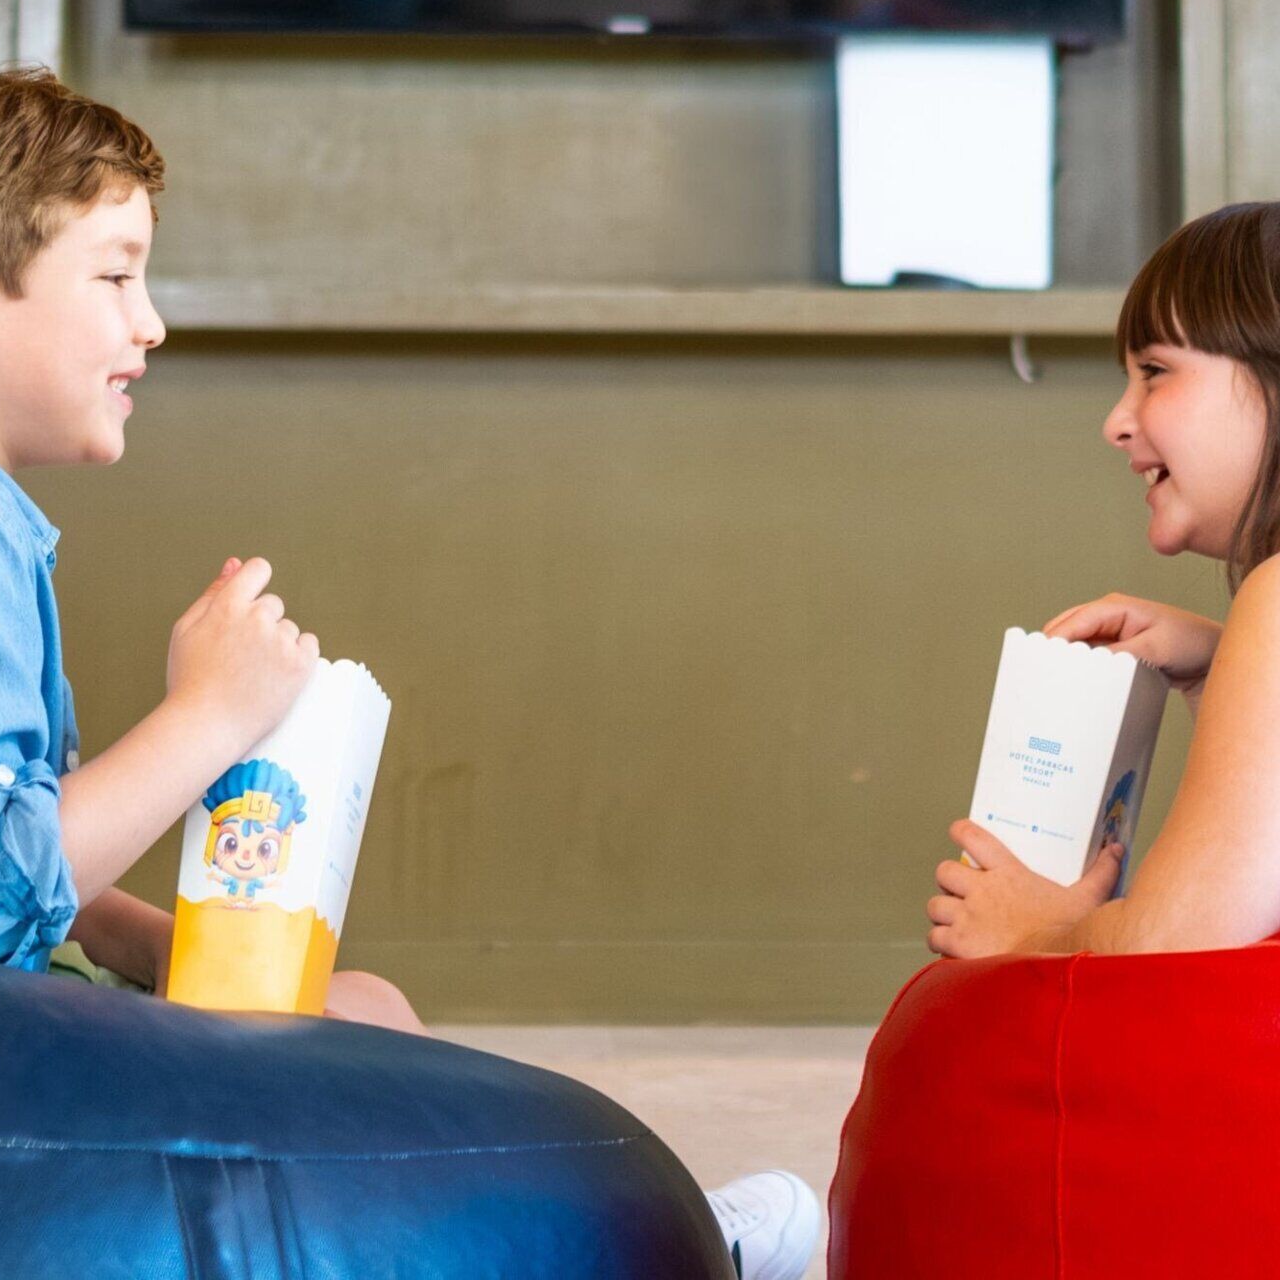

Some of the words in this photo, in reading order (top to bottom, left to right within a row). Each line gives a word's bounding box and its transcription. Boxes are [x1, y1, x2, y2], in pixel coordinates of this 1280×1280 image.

[1009, 752, 1034, 764] HOTEL
[1036, 758, 1074, 773] PARACAS
[1023, 764, 1054, 777] RESORT
